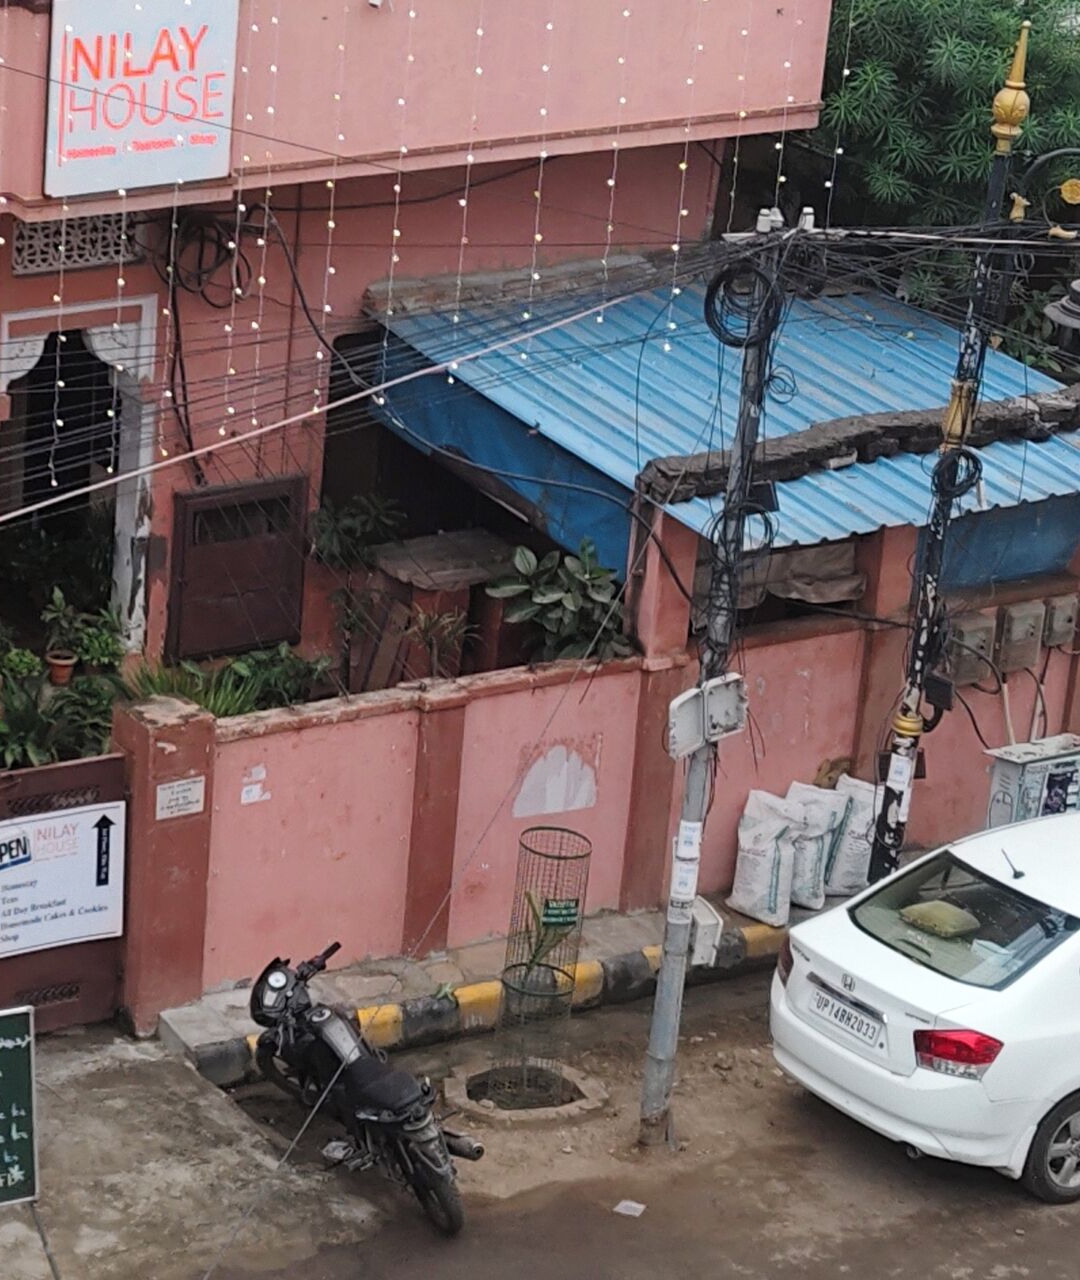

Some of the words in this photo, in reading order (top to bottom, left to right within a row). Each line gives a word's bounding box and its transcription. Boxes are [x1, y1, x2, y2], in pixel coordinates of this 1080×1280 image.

[71, 24, 208, 83] NILAY
[68, 72, 226, 133] HOUSE
[37, 823, 78, 840] NILAY
[13, 906, 27, 916] Day
[30, 897, 66, 911] Breakfast
